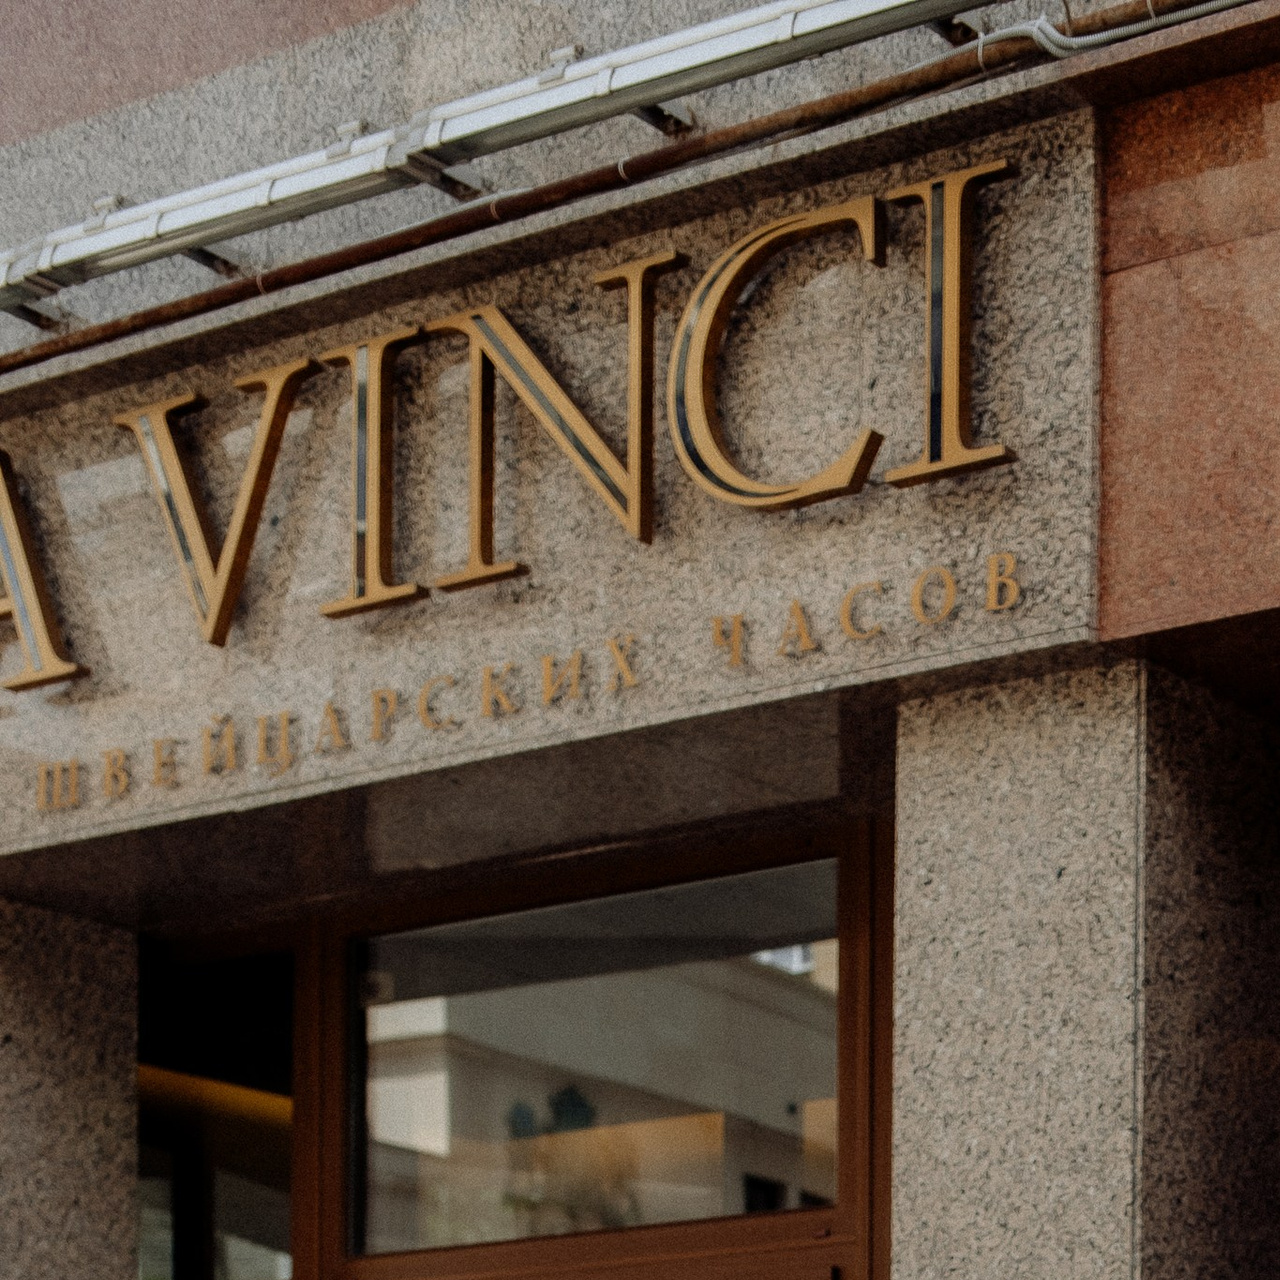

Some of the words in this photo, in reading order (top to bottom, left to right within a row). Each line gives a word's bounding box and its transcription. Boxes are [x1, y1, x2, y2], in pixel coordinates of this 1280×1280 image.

[113, 158, 1014, 646] VINCI
[36, 634, 638, 811] ШВЕЙЦАРСКИХ
[711, 551, 1021, 668] ЧАСОВ
